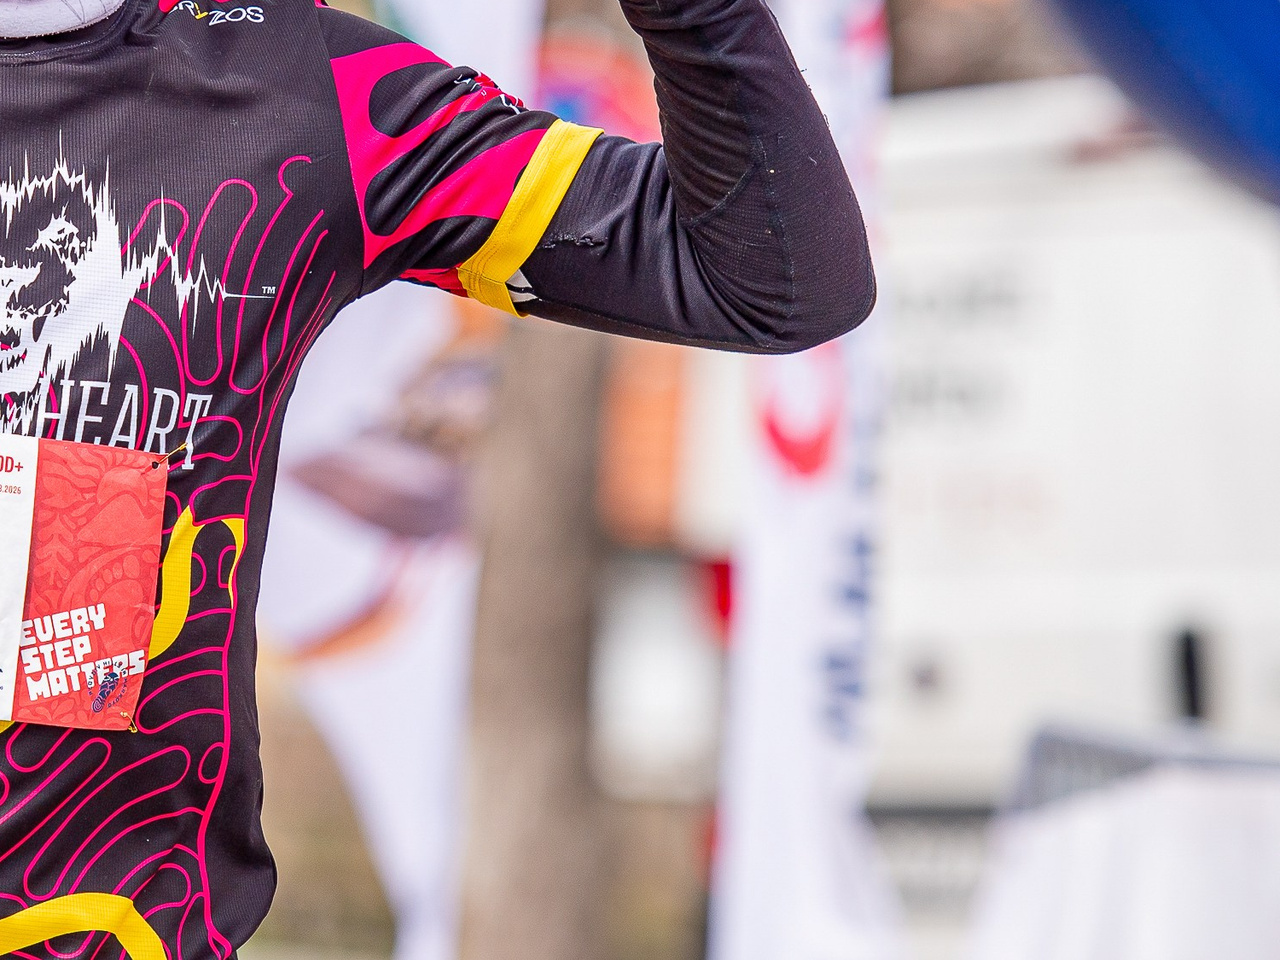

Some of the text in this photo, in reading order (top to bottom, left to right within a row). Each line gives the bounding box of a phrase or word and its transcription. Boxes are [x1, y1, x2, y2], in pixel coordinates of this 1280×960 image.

[37, 376, 213, 471] HEART
[19, 603, 106, 647] EVERY
[21, 635, 91, 674] STEP
[26, 649, 145, 701] MATTERS
